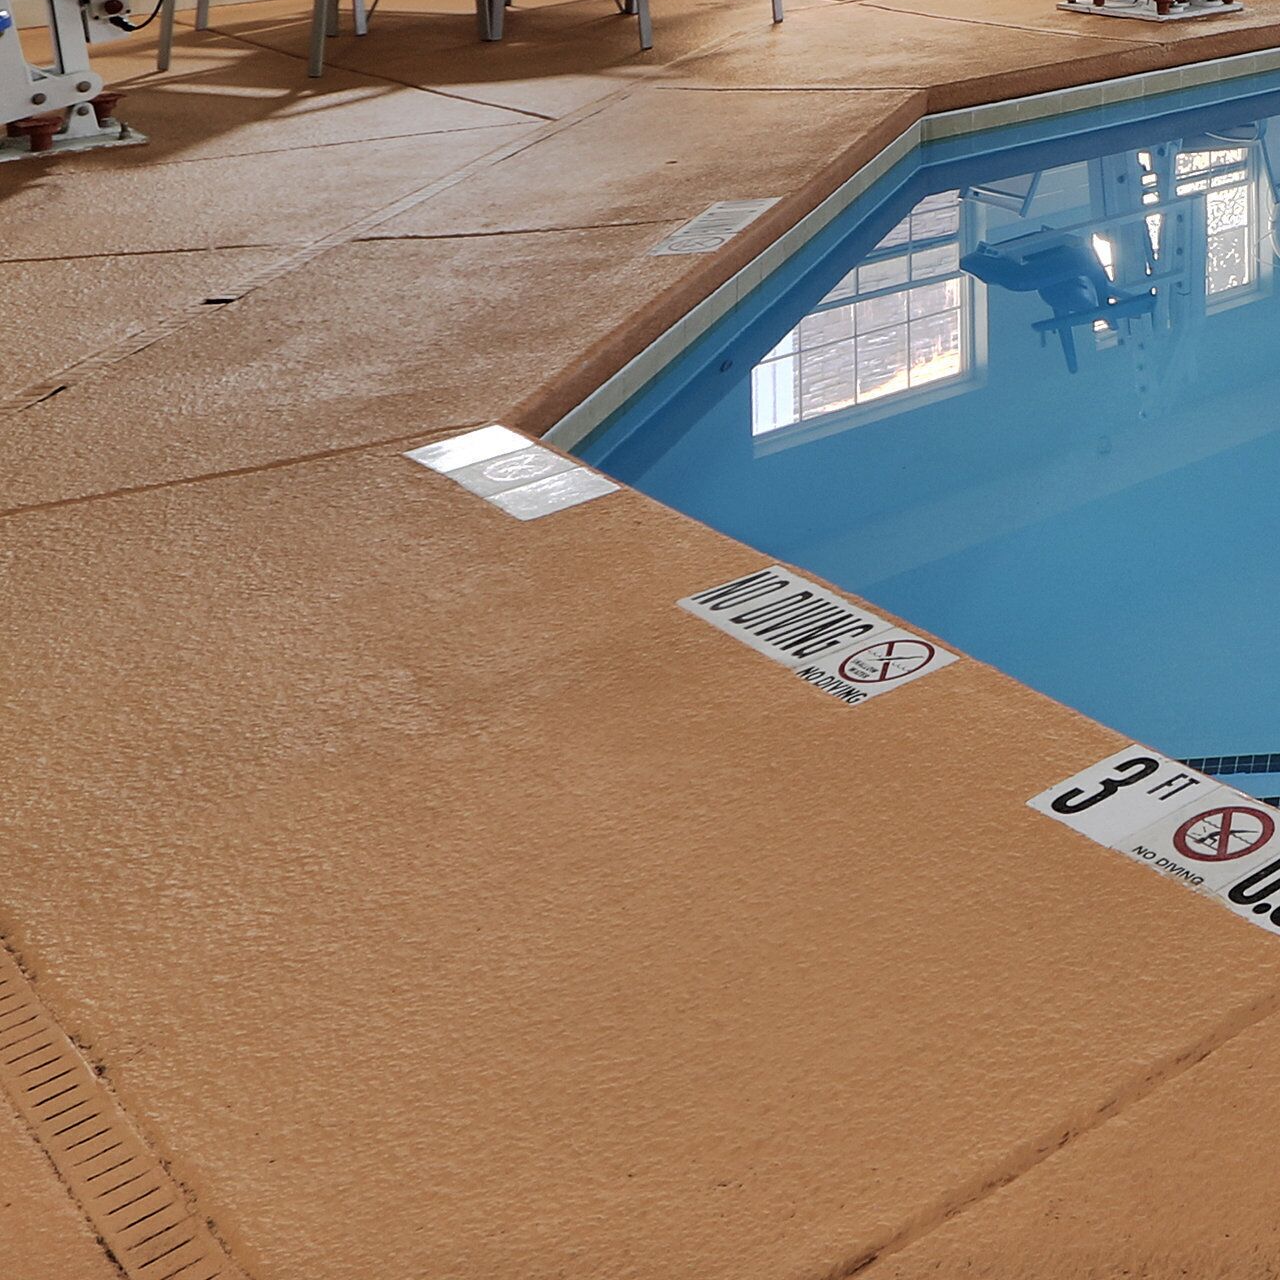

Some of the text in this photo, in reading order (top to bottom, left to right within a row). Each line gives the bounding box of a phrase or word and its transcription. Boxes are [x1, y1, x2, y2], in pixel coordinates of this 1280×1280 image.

[691, 571, 874, 659] NO DIVING
[796, 665, 868, 704] NO DIVING
[1051, 756, 1200, 815] 3 FT
[1132, 845, 1205, 886] NO DIVING
